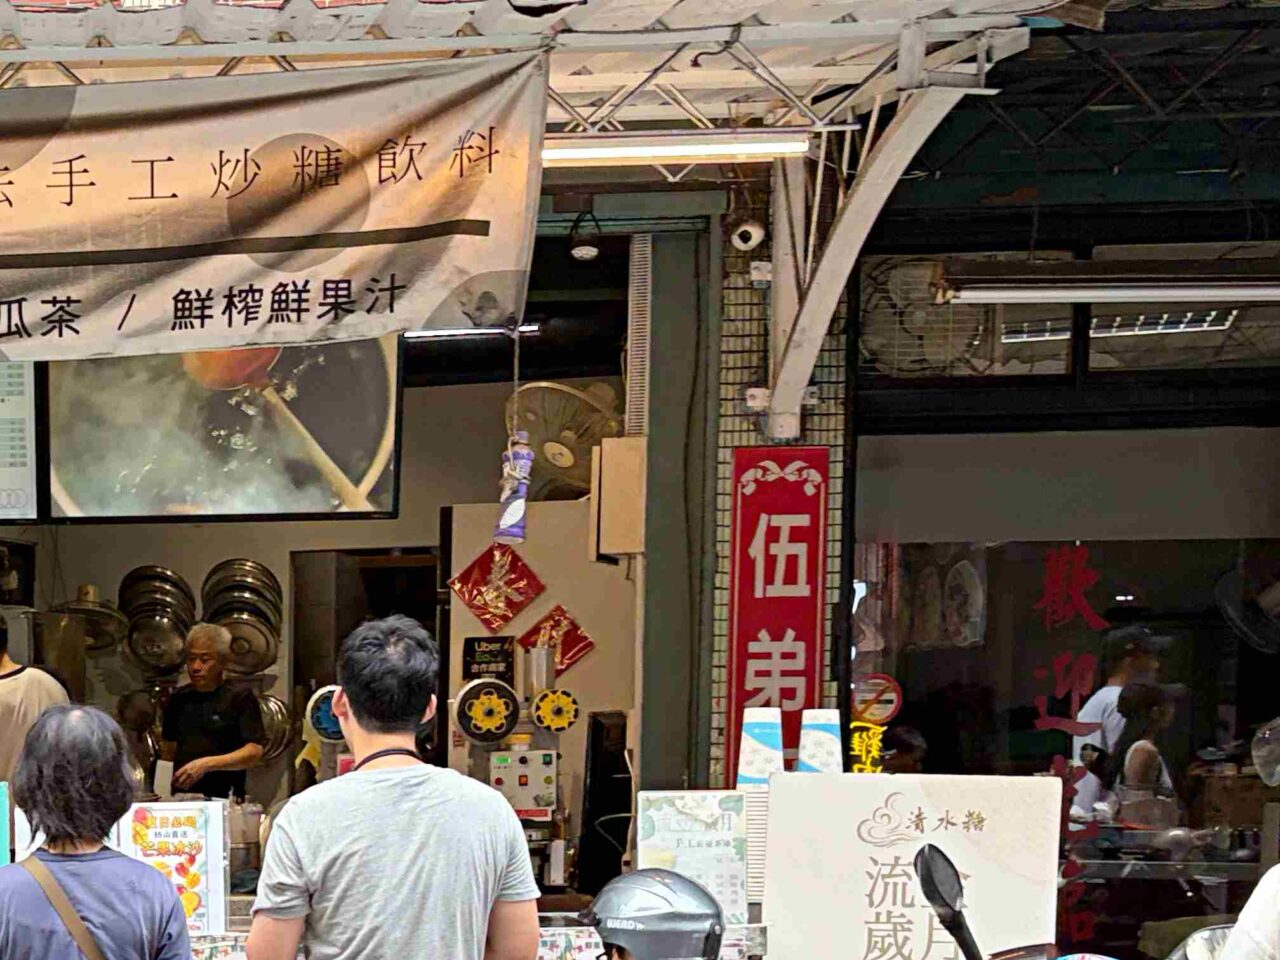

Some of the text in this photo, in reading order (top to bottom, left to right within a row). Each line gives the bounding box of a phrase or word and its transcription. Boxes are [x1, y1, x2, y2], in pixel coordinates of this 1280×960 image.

[170, 272, 408, 332] 鮮榨鮮果汁
[743, 512, 812, 768] 伍弟
[905, 808, 988, 834] 清水糖
